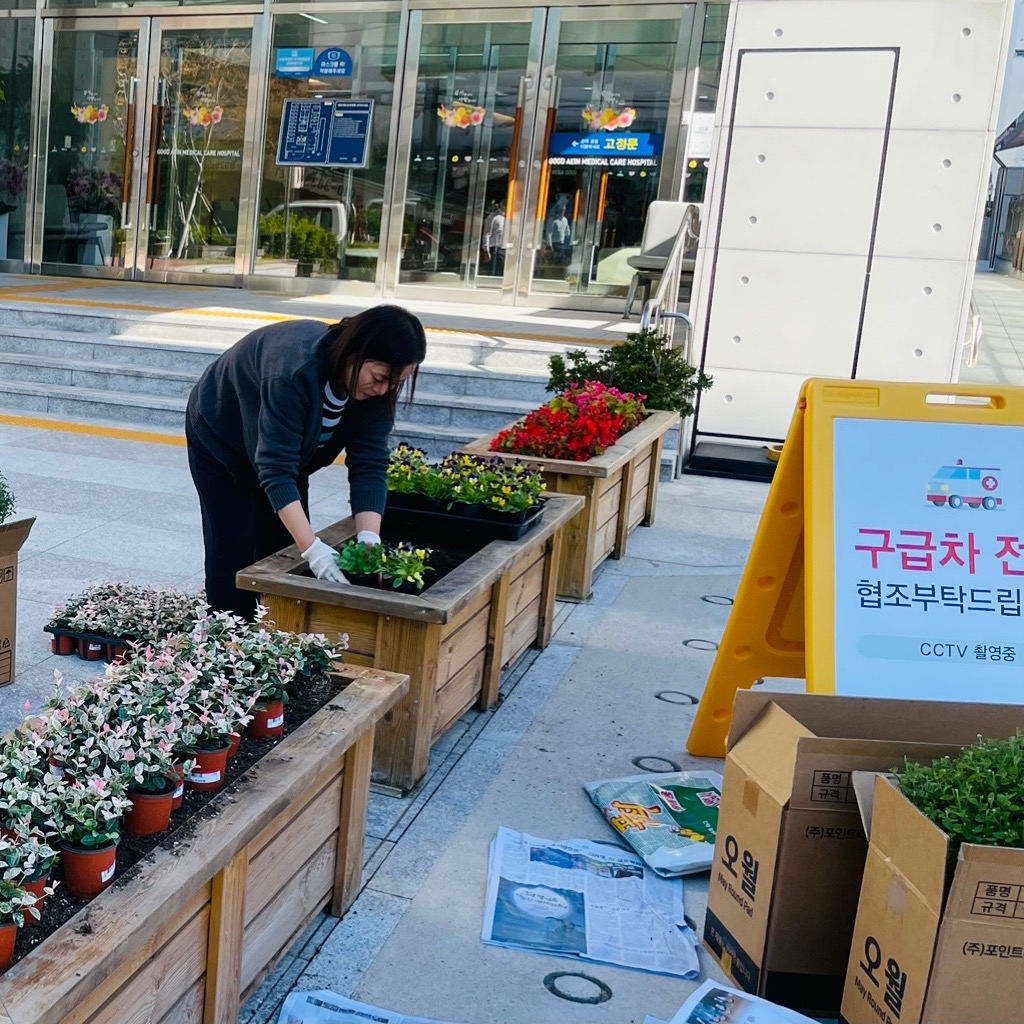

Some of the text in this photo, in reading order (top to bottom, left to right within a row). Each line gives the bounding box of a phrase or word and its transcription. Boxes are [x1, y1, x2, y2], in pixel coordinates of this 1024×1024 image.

[603, 137, 639, 151] 고정문
[203, 149, 217, 157] CARE
[217, 150, 241, 158] HOSPITAL
[548, 157, 566, 165] GOOD
[581, 158, 609, 166] MEDICAL
[609, 158, 627, 166] CARE
[626, 158, 657, 166] HOSPITAL
[854, 528, 981, 575] 구급차
[856, 579, 1021, 617] 협조부탁드립
[920, 642, 1016, 662] CCTV 촬영중
[820, 772, 842, 785] 품명
[818, 788, 840, 801] 규격
[721, 835, 760, 903] 오월
[717, 871, 754, 919] May Round Pad
[985, 884, 1012, 898] 품명
[981, 901, 1007, 915] 규격
[859, 935, 908, 1020] 오월
[854, 975, 868, 999] May
[866, 990, 886, 1022] Round
